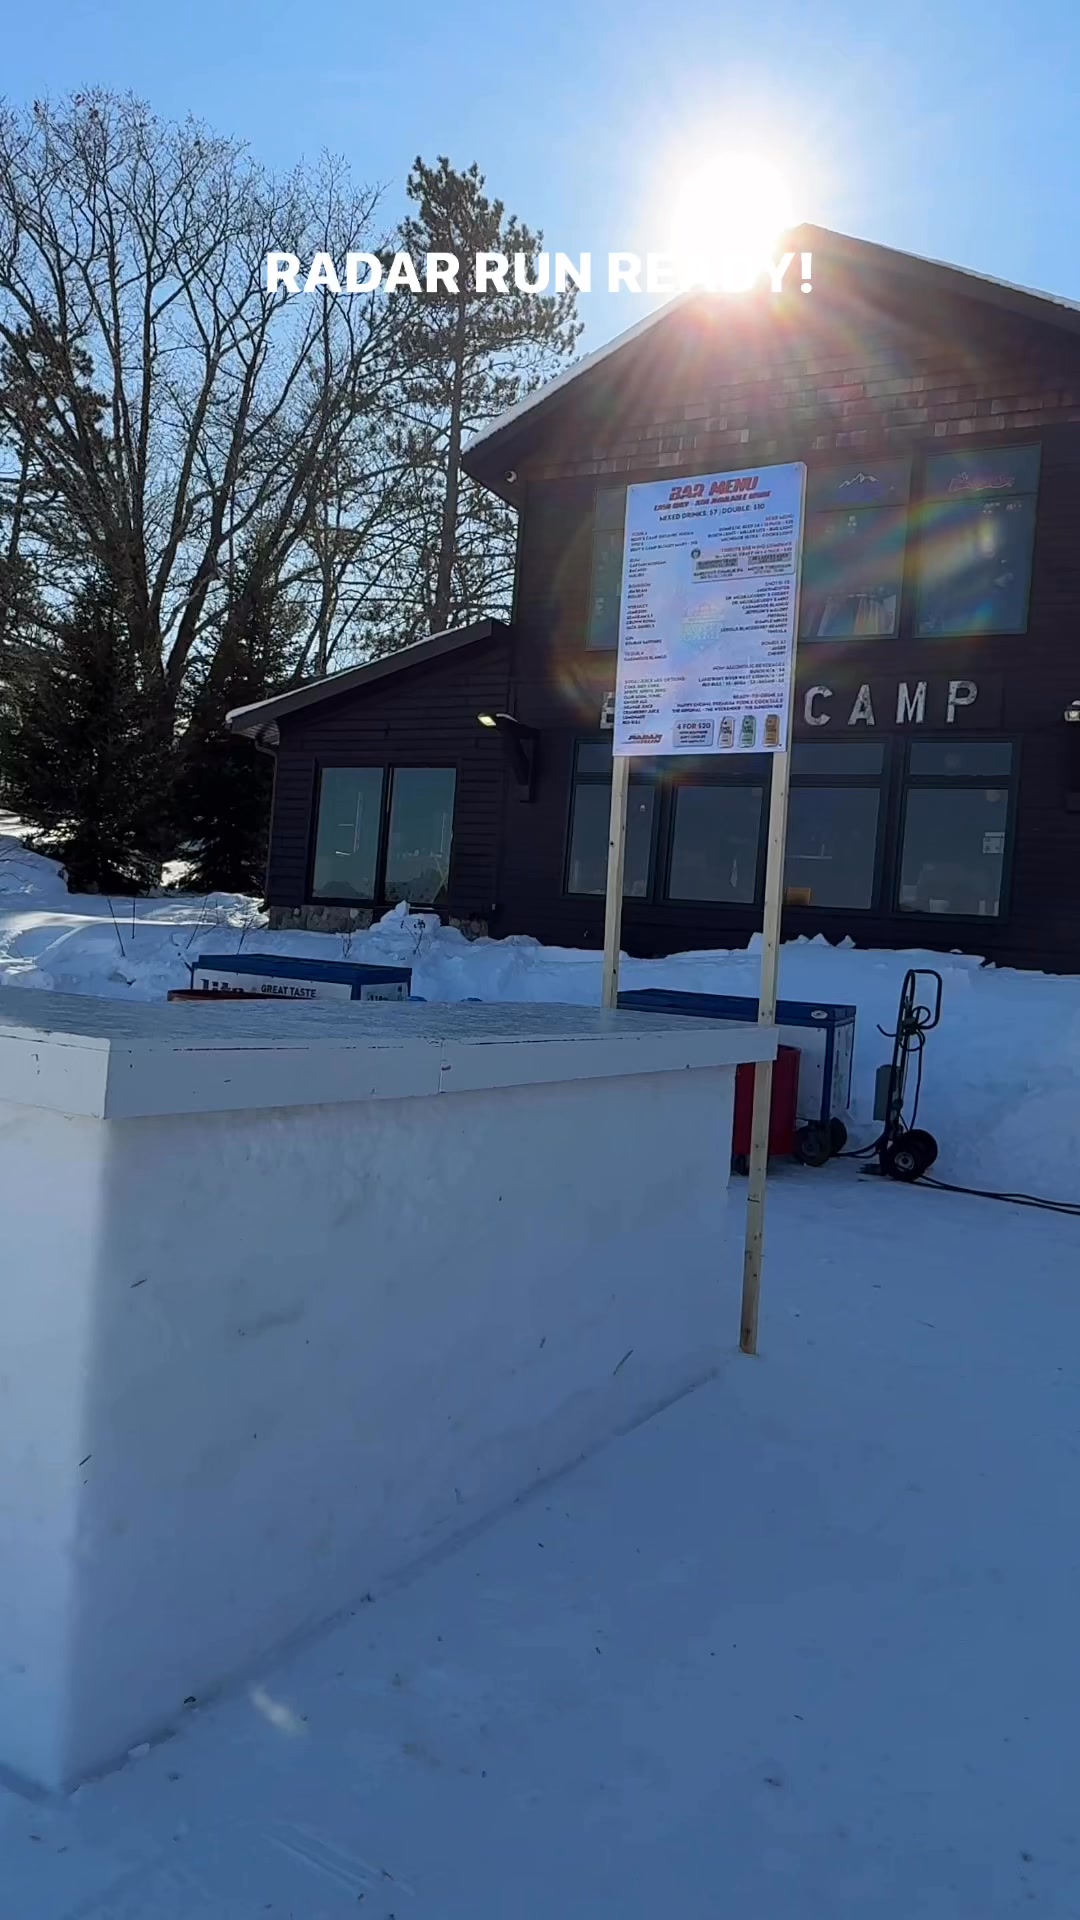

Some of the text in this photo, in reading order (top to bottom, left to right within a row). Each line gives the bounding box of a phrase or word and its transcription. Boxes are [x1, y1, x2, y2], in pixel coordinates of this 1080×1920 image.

[669, 476, 759, 500] BAR MENU
[660, 512, 680, 522] MIXED
[709, 508, 718, 516] $7
[753, 503, 765, 511] $10
[804, 680, 978, 726] CAMP
[260, 984, 288, 996] GREAT
[289, 986, 316, 998] TASTE
